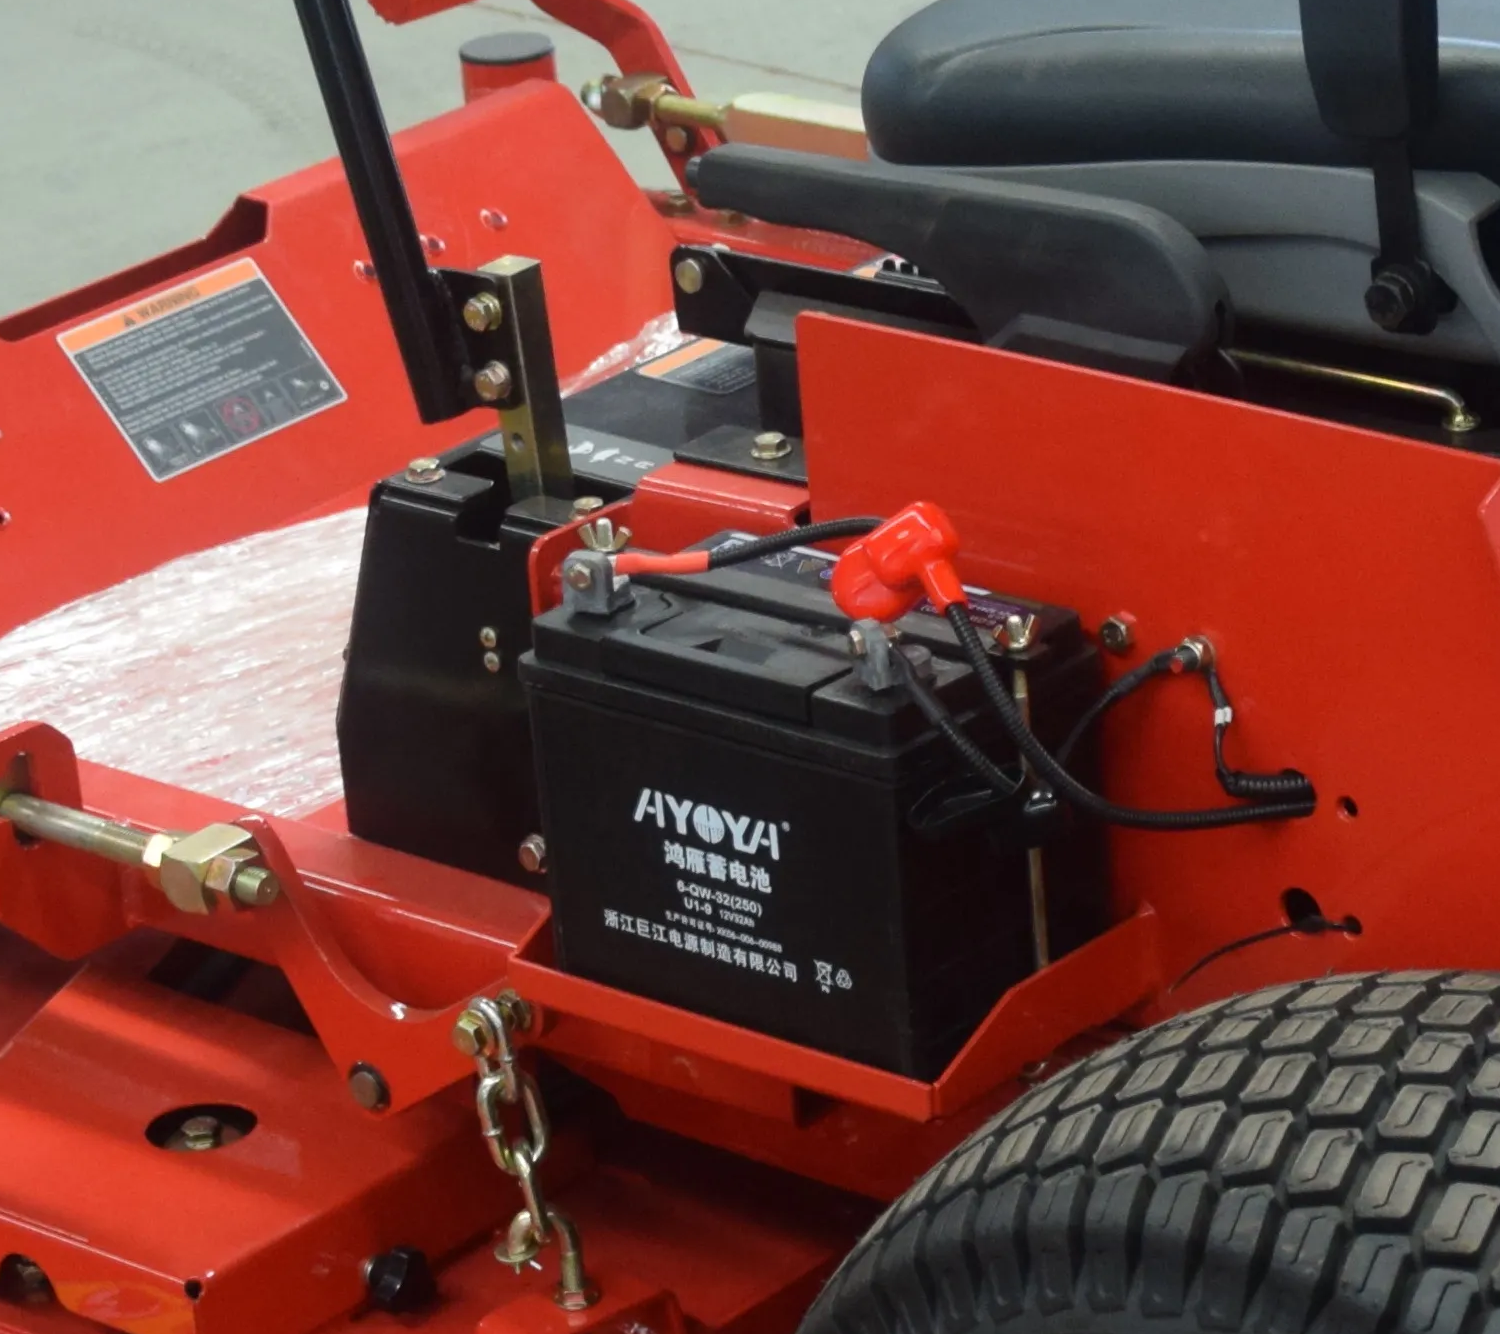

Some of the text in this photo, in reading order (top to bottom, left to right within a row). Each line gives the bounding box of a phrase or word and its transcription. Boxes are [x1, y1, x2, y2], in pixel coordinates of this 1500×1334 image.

[663, 840, 773, 894] 鸿雁蓄电池
[676, 879, 763, 918] 6-QW-32(250)
